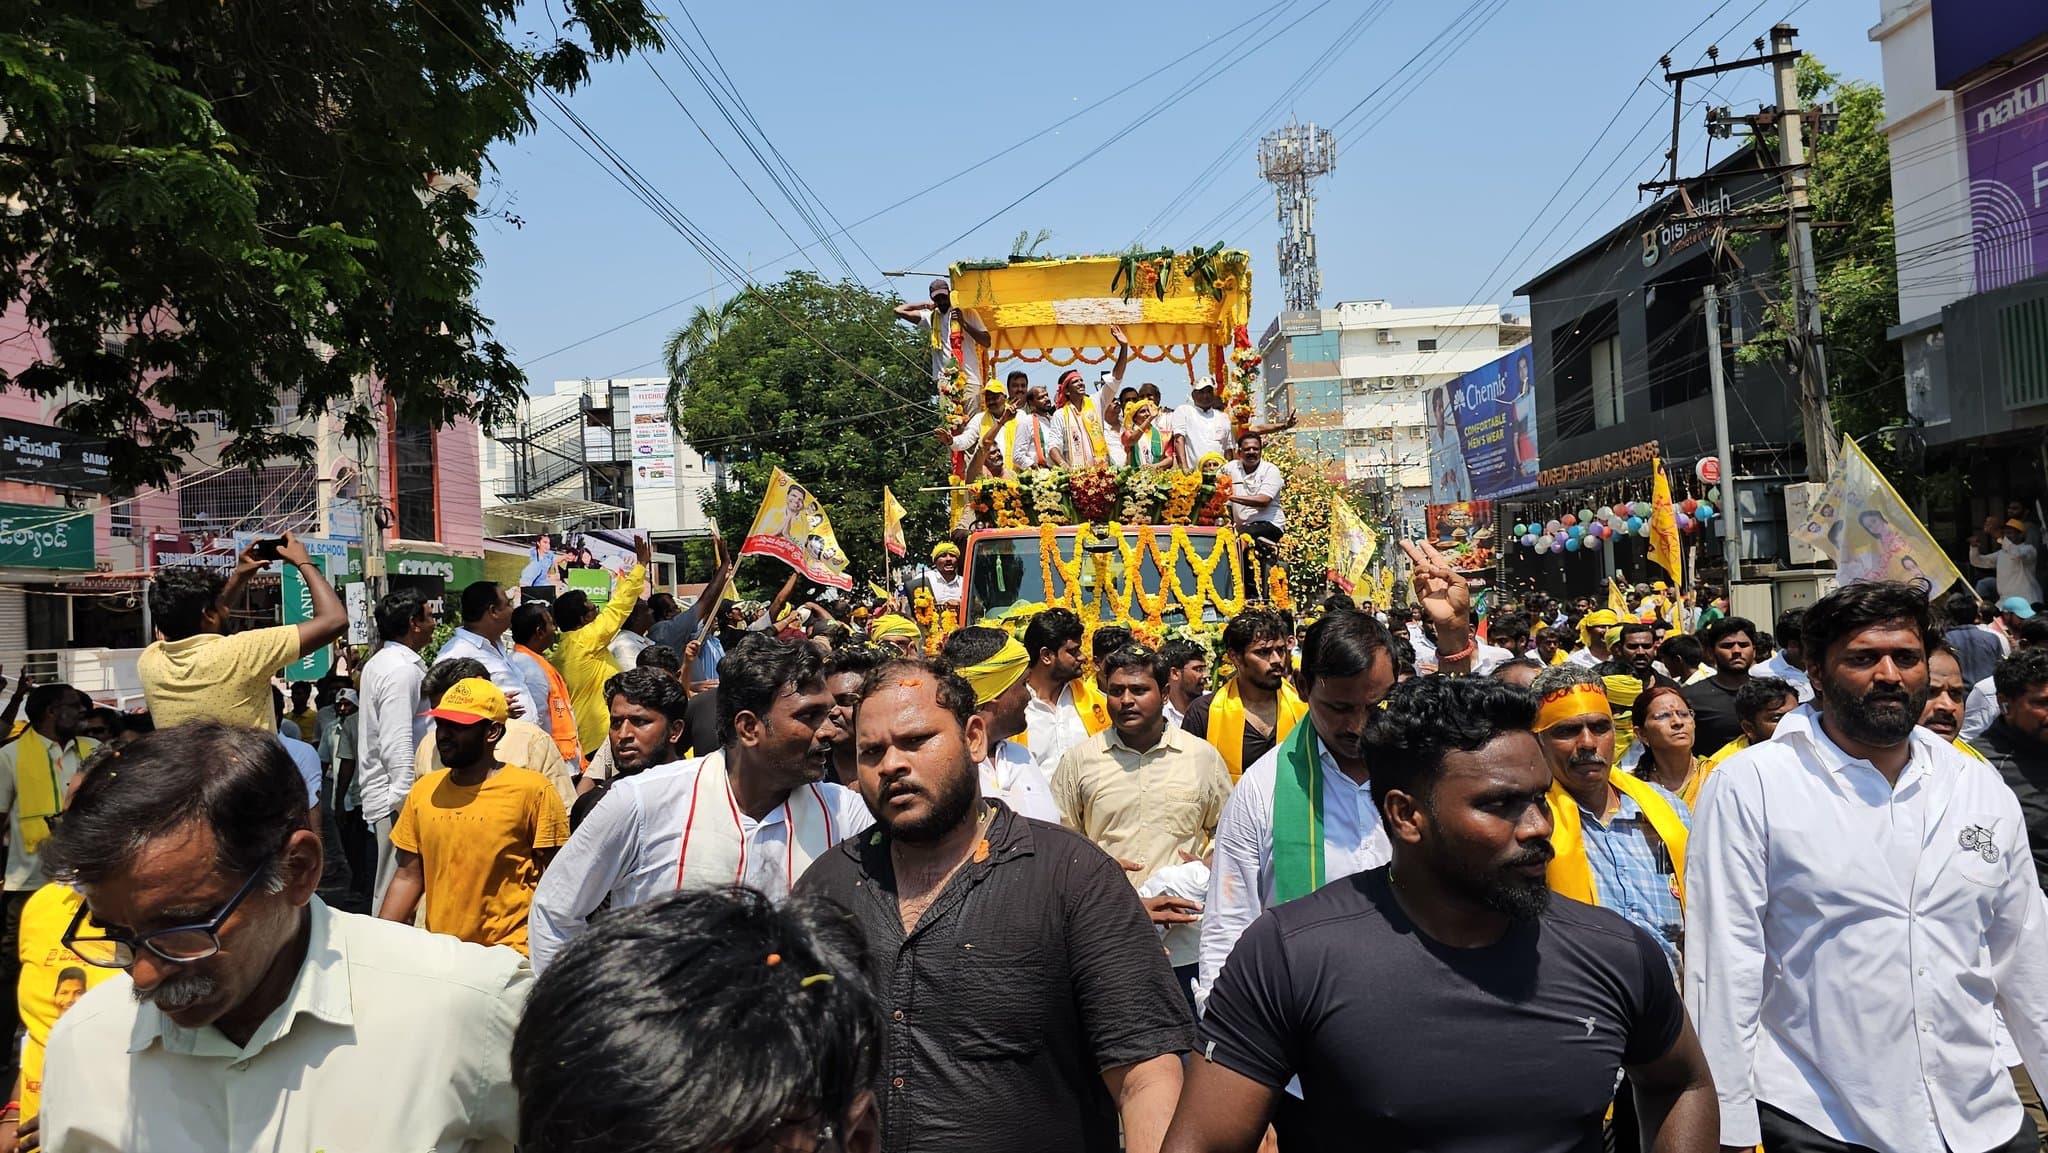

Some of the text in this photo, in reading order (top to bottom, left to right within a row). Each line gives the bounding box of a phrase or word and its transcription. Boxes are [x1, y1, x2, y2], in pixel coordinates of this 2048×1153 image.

[1466, 373, 1505, 410] Chennis
[1464, 413, 1506, 437] COMFORTABLE
[1486, 429, 1505, 444] WEAR
[82, 452, 110, 466] SAMS
[317, 544, 346, 556] SCHOOL
